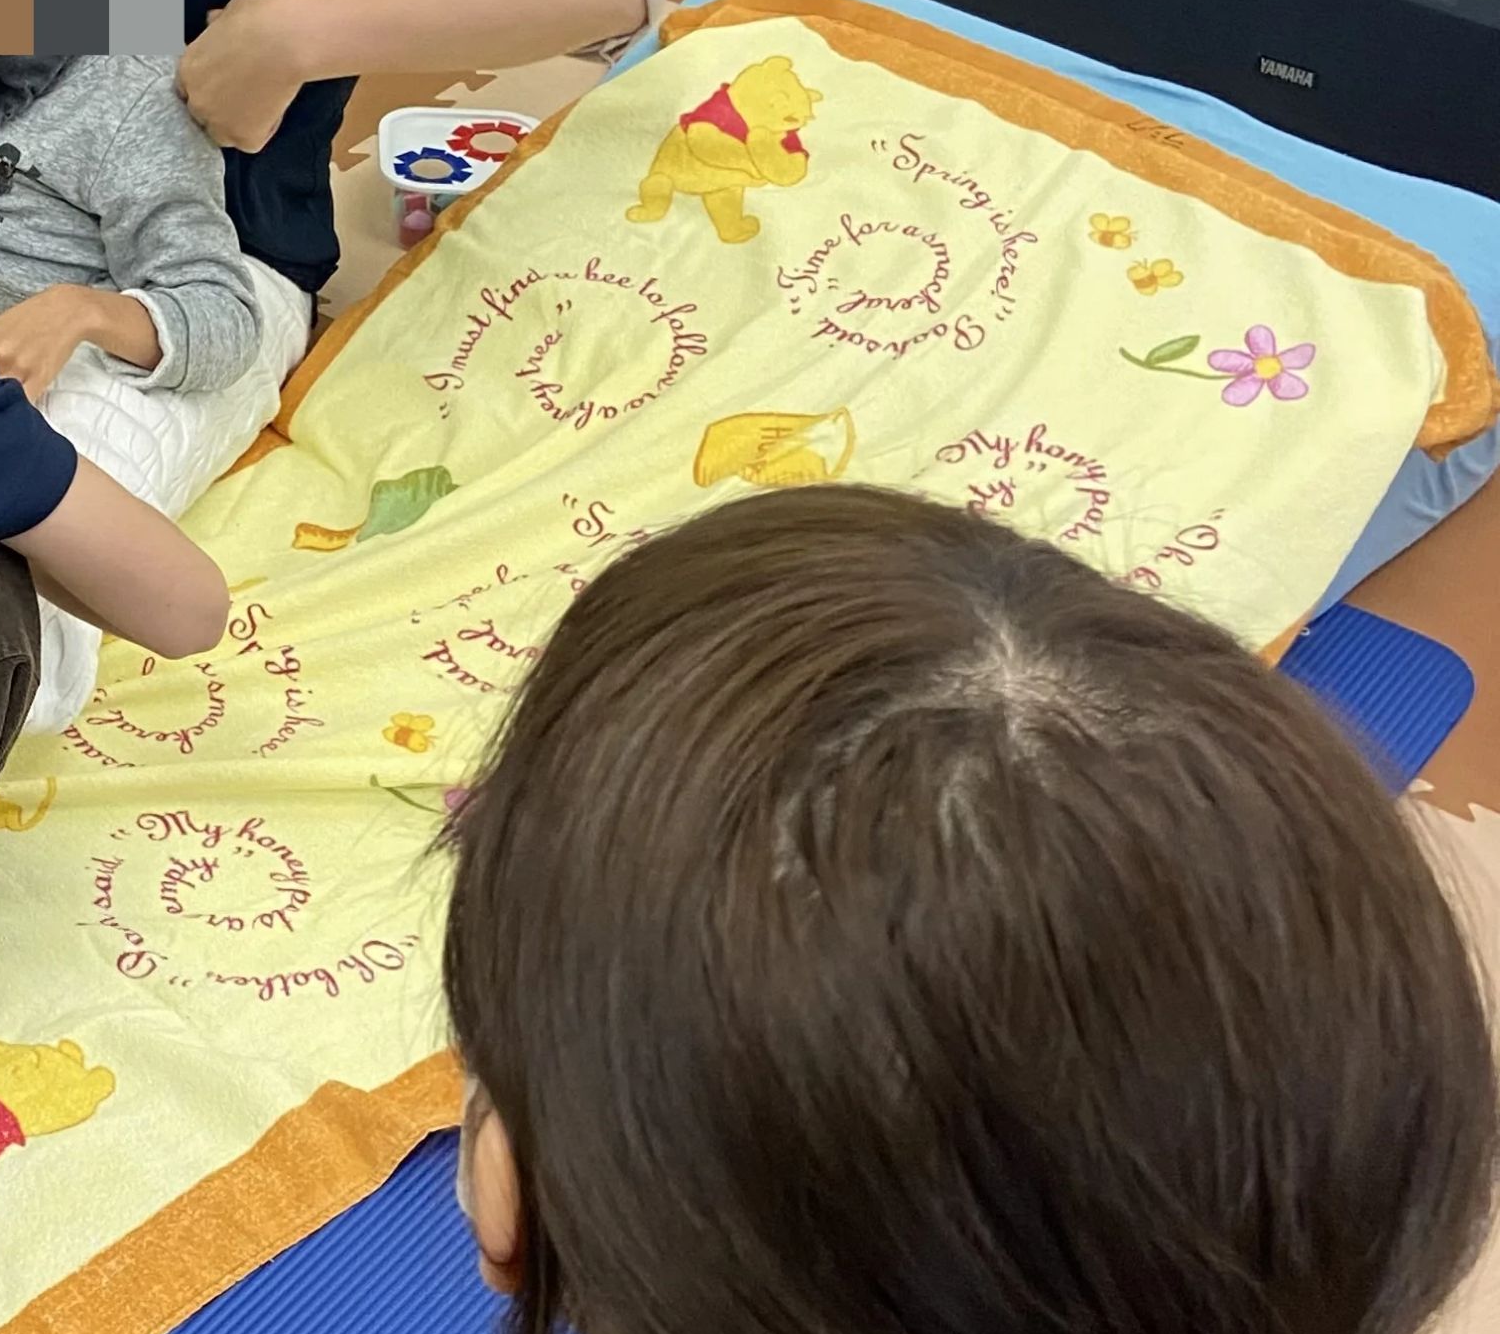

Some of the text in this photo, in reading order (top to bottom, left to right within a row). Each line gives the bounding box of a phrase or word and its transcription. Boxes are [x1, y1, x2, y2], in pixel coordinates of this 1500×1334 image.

[1260, 56, 1314, 89] YAMAHA
[840, 213, 901, 247] for
[902, 222, 926, 238] a
[988, 209, 1014, 236] is
[480, 267, 547, 321] find
[584, 257, 636, 289] bee
[638, 277, 668, 307] to
[451, 312, 492, 371] must
[650, 303, 708, 393] follow
[530, 379, 595, 430] hney
[597, 404, 619, 420] a
[1024, 423, 1108, 483] hony
[228, 603, 302, 683] Spng
[284, 688, 314, 715] is
[236, 816, 311, 886] honey
